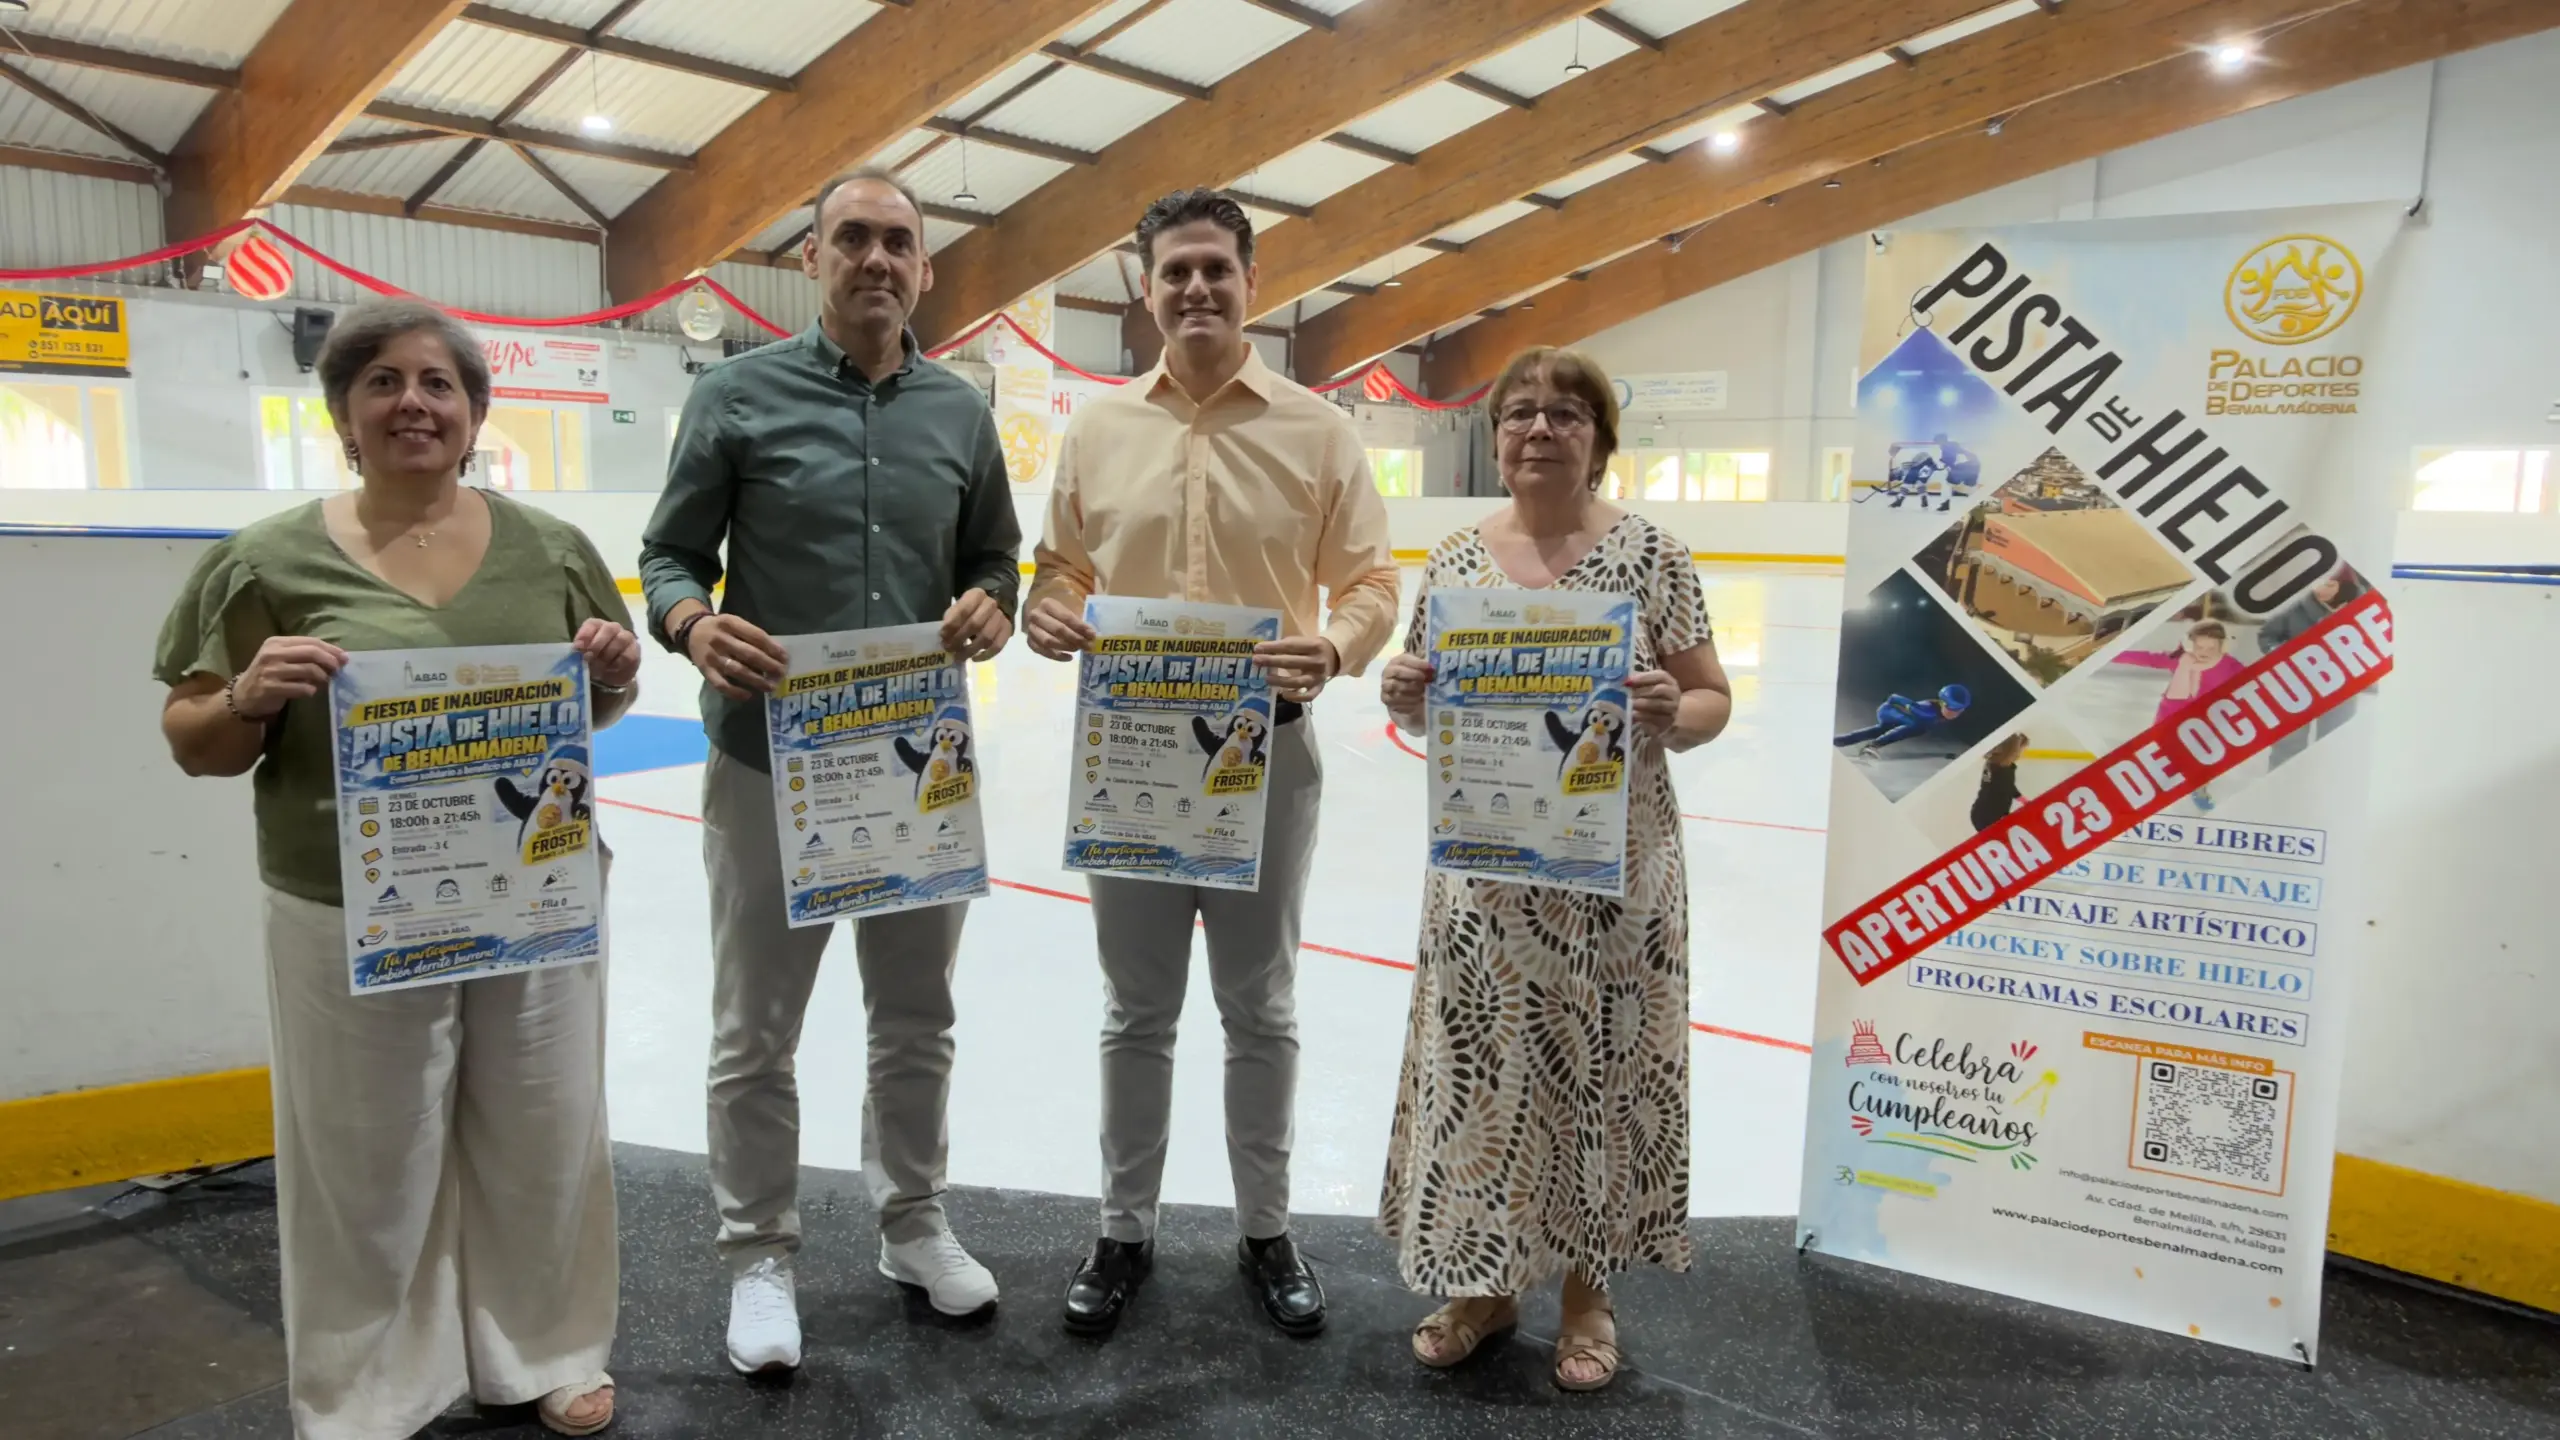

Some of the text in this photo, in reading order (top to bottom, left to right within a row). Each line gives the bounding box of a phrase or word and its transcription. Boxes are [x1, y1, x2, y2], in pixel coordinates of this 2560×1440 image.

[44, 303, 112, 327] AQUÍ
[2207, 381, 2360, 402] DE DEPORTES
[1051, 391, 1072, 415] Hi
[1913, 242, 2338, 614] PISTA DE HIELO
[1143, 619, 1168, 628] ABAD
[1102, 639, 1140, 652] FIESTA
[1145, 640, 1159, 651] DE
[1449, 627, 1611, 646] FIESTA DE INAUGURACIÓN
[415, 672, 448, 682] ABAD
[789, 652, 946, 692] FIESTA DE INAUGURACIÓN
[1089, 654, 1163, 689] PISTA
[1169, 660, 1192, 681] DE
[1438, 647, 1625, 686] PISTA DE HIELO
[1110, 684, 1124, 696] DE
[1459, 679, 1474, 692] DE
[364, 681, 562, 721] FIESTA DE INAUGURACIÓN
[780, 683, 858, 733] PISTA
[862, 683, 884, 704] DE
[885, 667, 960, 704] HIELO
[351, 701, 581, 769] PISTA DE HIELO
[804, 720, 820, 736] DE
[1110, 720, 1176, 736] 23 DE OCTUBRE
[1461, 718, 1528, 731] 23 DE OCTUBRE
[1109, 734, 1138, 746] 18:00h
[1149, 738, 1178, 749] 21:45h
[1461, 732, 1531, 747] 18:00h a 21:45h
[383, 756, 403, 773] DE
[810, 760, 822, 770] 23
[824, 758, 835, 768] DE
[837, 752, 880, 766] OCTUBRE
[1108, 757, 1133, 766] Entrada
[812, 767, 885, 784] 18:00h a 21:45h
[1213, 774, 1258, 787] FROSTY
[1569, 770, 1618, 786] FROSTY
[926, 781, 969, 805] FROSTY
[1838, 602, 2393, 975] APERTURA 23 DE OCTUBRE
[388, 794, 476, 813] 23 DE OCTUBRE
[390, 811, 481, 829] 18:00h a 21:45h
[531, 829, 584, 854] FROSTY
[1214, 828, 1229, 837] Fila
[1573, 829, 1588, 838] Fila
[2197, 826, 2316, 857] LIBRES
[392, 844, 426, 855] Entrada
[434, 842, 441, 850] 3
[937, 842, 954, 851] Fila
[1108, 854, 1137, 866] derrite
[1140, 855, 1177, 866] barreras!
[2103, 862, 2144, 884] DE
[2157, 867, 2311, 904] PATINAJE
[541, 898, 567, 908] Fila 0
[2000, 895, 2307, 949] ATINAJE ARTÍSTICO
[366, 944, 501, 986] también derrite barreras!
[1944, 930, 2302, 994] HOCKEY SOBRE HIELO
[1916, 966, 2298, 1039] PROGRAMAS ESCOLARES
[1895, 1032, 2024, 1085] Celebra
[2089, 1036, 2265, 1072] ESCANEA PARA MÁS INFO
[1870, 1071, 2006, 1105] con nosotros tu
[1848, 1081, 2038, 1147] Cumpleaños
[2085, 1193, 2104, 1206] Av.
[2108, 1198, 2146, 1213] Cdad.
[2149, 1206, 2166, 1217] de
[2220, 1221, 2244, 1235] s/n,
[2248, 1226, 2287, 1242] 29631
[2133, 1215, 2231, 1244] Benalmádena,
[1991, 1205, 2284, 1276] www.palaciodeportesbenalmadena.com
